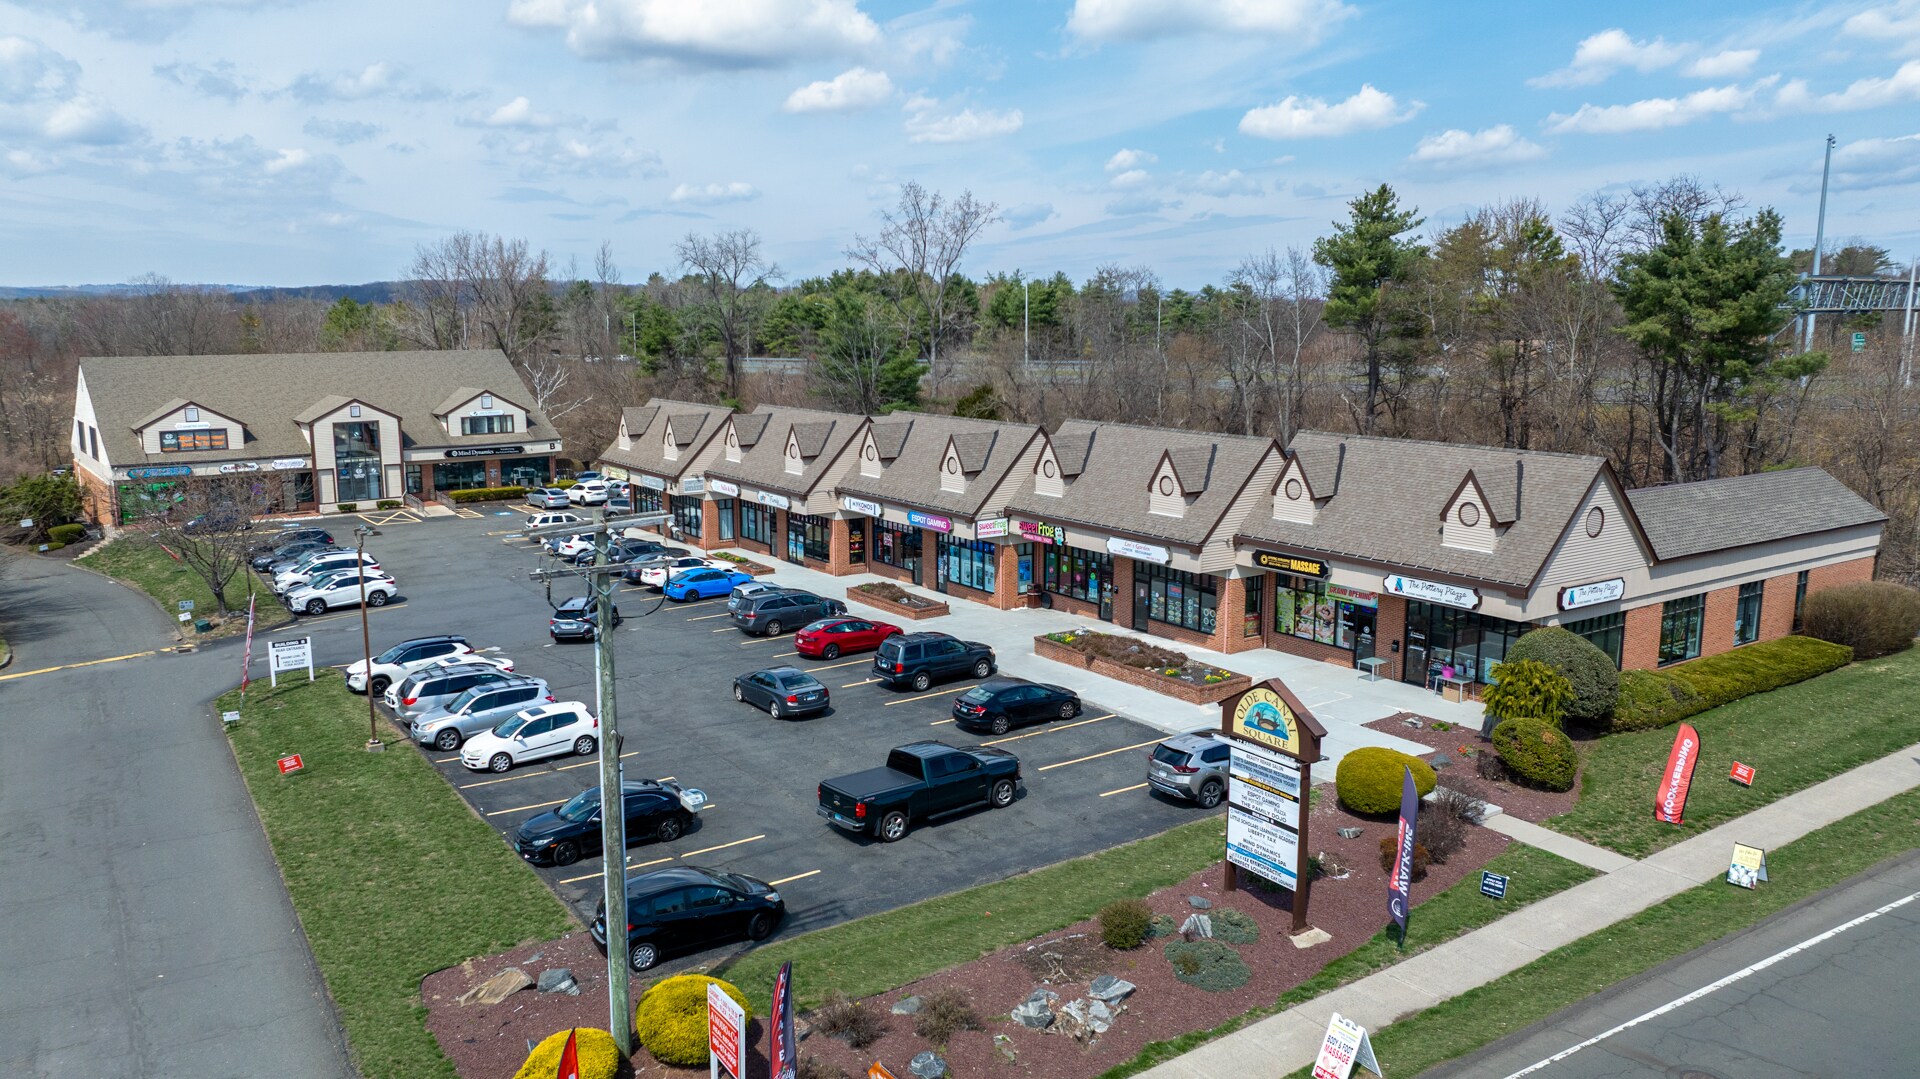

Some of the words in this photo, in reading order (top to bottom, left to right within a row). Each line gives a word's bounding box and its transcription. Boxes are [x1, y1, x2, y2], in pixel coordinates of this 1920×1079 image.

[472, 449, 494, 457] Dynamics
[852, 502, 873, 511] MYKONOS
[911, 514, 926, 525] ESPOT
[926, 516, 947, 529] GAMING
[1019, 521, 1055, 537] sweetFrog
[1135, 543, 1151, 551] Garden
[1290, 559, 1320, 574] MASSAGE
[1329, 586, 1347, 595] GRAND
[1348, 588, 1371, 600] OPENING
[1408, 579, 1420, 589] The
[1420, 582, 1443, 596] Pottery
[1445, 586, 1467, 601] Piazza
[1587, 586, 1603, 595] Pottery
[1236, 691, 1260, 720] OLDE
[1264, 691, 1296, 737] CANAL
[1243, 727, 1289, 750] SQUARE
[1246, 754, 1260, 762] BEAUTY
[1260, 758, 1272, 767] REHAB
[1272, 763, 1284, 772] SALON
[1273, 769, 1296, 782] RESTAURANT
[1284, 779, 1297, 789] YOGURT
[1243, 783, 1264, 795] MYKONOS
[1264, 791, 1285, 803] EXPRESS
[1247, 791, 1261, 801] ESPOT
[1262, 797, 1280, 808] GAMING
[1241, 800, 1251, 808] THE
[1252, 804, 1271, 817] FAMILY
[1271, 812, 1287, 822] DOJO
[1241, 818, 1259, 830] SCHOLARS
[1260, 827, 1278, 838] LEARNING
[1278, 835, 1296, 846] ACADEMY
[1248, 828, 1266, 840] LIBERTY
[1267, 836, 1276, 844] TAX
[1237, 842, 1253, 852] JEWELS
[1254, 848, 1277, 862] GLAMOUR
[1243, 838, 1255, 847] MIND
[1256, 843, 1281, 858] DYNAMICS
[1229, 855, 1250, 868] PURRFECT
[1250, 866, 1270, 878] LOUNGE
[1278, 878, 1294, 889] LOUNGE
[778, 973, 786, 1062] KARATE
[712, 1024, 722, 1039] REAL
[723, 1034, 736, 1053] ESTATE
[1327, 1034, 1339, 1047] BODY
[1338, 1042, 1343, 1050] &
[1342, 1043, 1354, 1056] FOOT
[1324, 1043, 1351, 1065] MASSAGE
